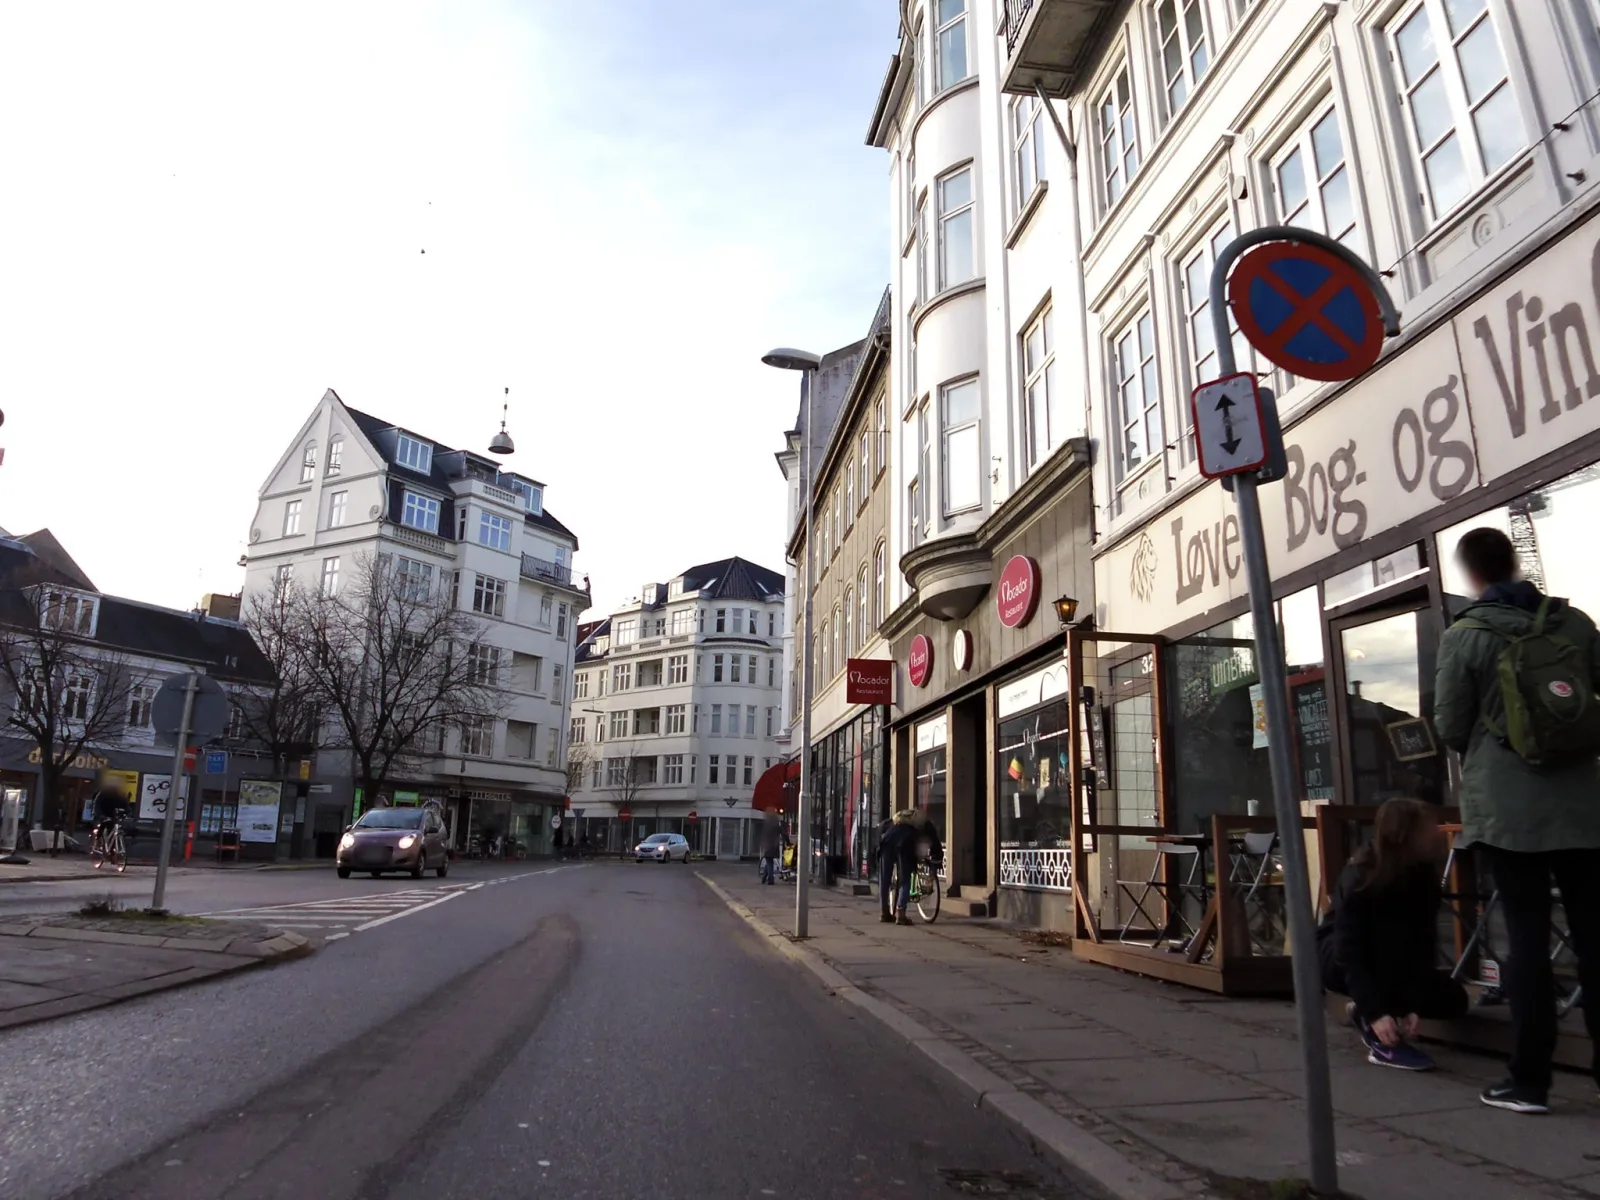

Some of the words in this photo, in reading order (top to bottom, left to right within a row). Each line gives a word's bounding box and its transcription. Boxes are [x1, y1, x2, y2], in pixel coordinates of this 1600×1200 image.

[1171, 513, 1244, 605] Løve
[1392, 374, 1476, 502] og
[1474, 242, 1600, 439] Vin
[1141, 654, 1154, 675] 32
[849, 670, 890, 685] Mogador
